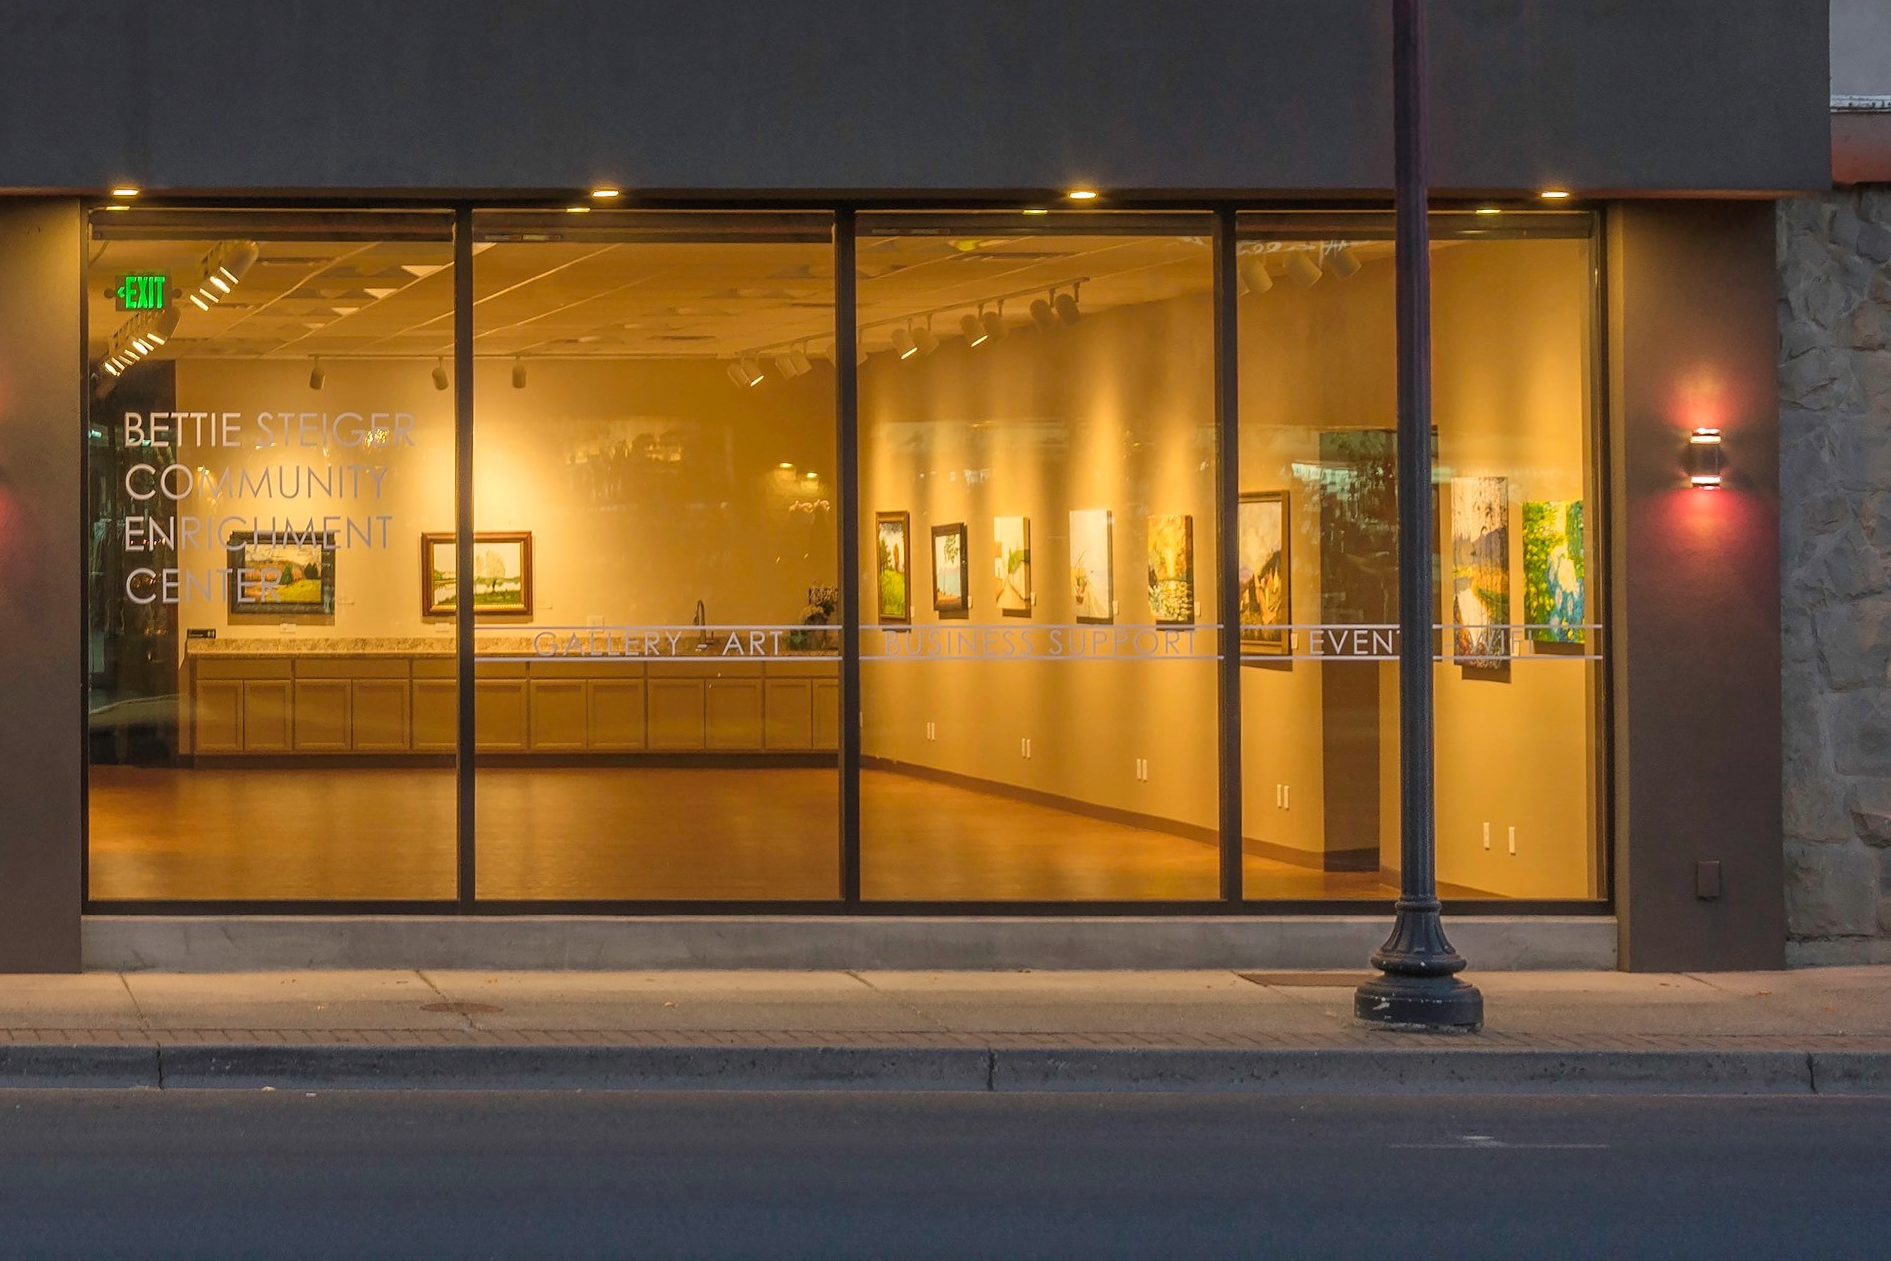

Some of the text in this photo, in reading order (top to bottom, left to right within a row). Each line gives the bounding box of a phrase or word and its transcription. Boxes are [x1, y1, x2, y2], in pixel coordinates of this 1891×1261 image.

[125, 276, 165, 309] EXIT
[124, 411, 415, 448] BETTIE STEIGER
[125, 463, 389, 501] COMMUNITY
[124, 515, 393, 552] ENRICHMENT
[126, 567, 282, 604] CENTER
[532, 631, 682, 657] GALLERY
[722, 630, 784, 656] ART
[883, 629, 1197, 656] BUSINESS SUPPORT
[1309, 630, 1400, 655] EVEN
